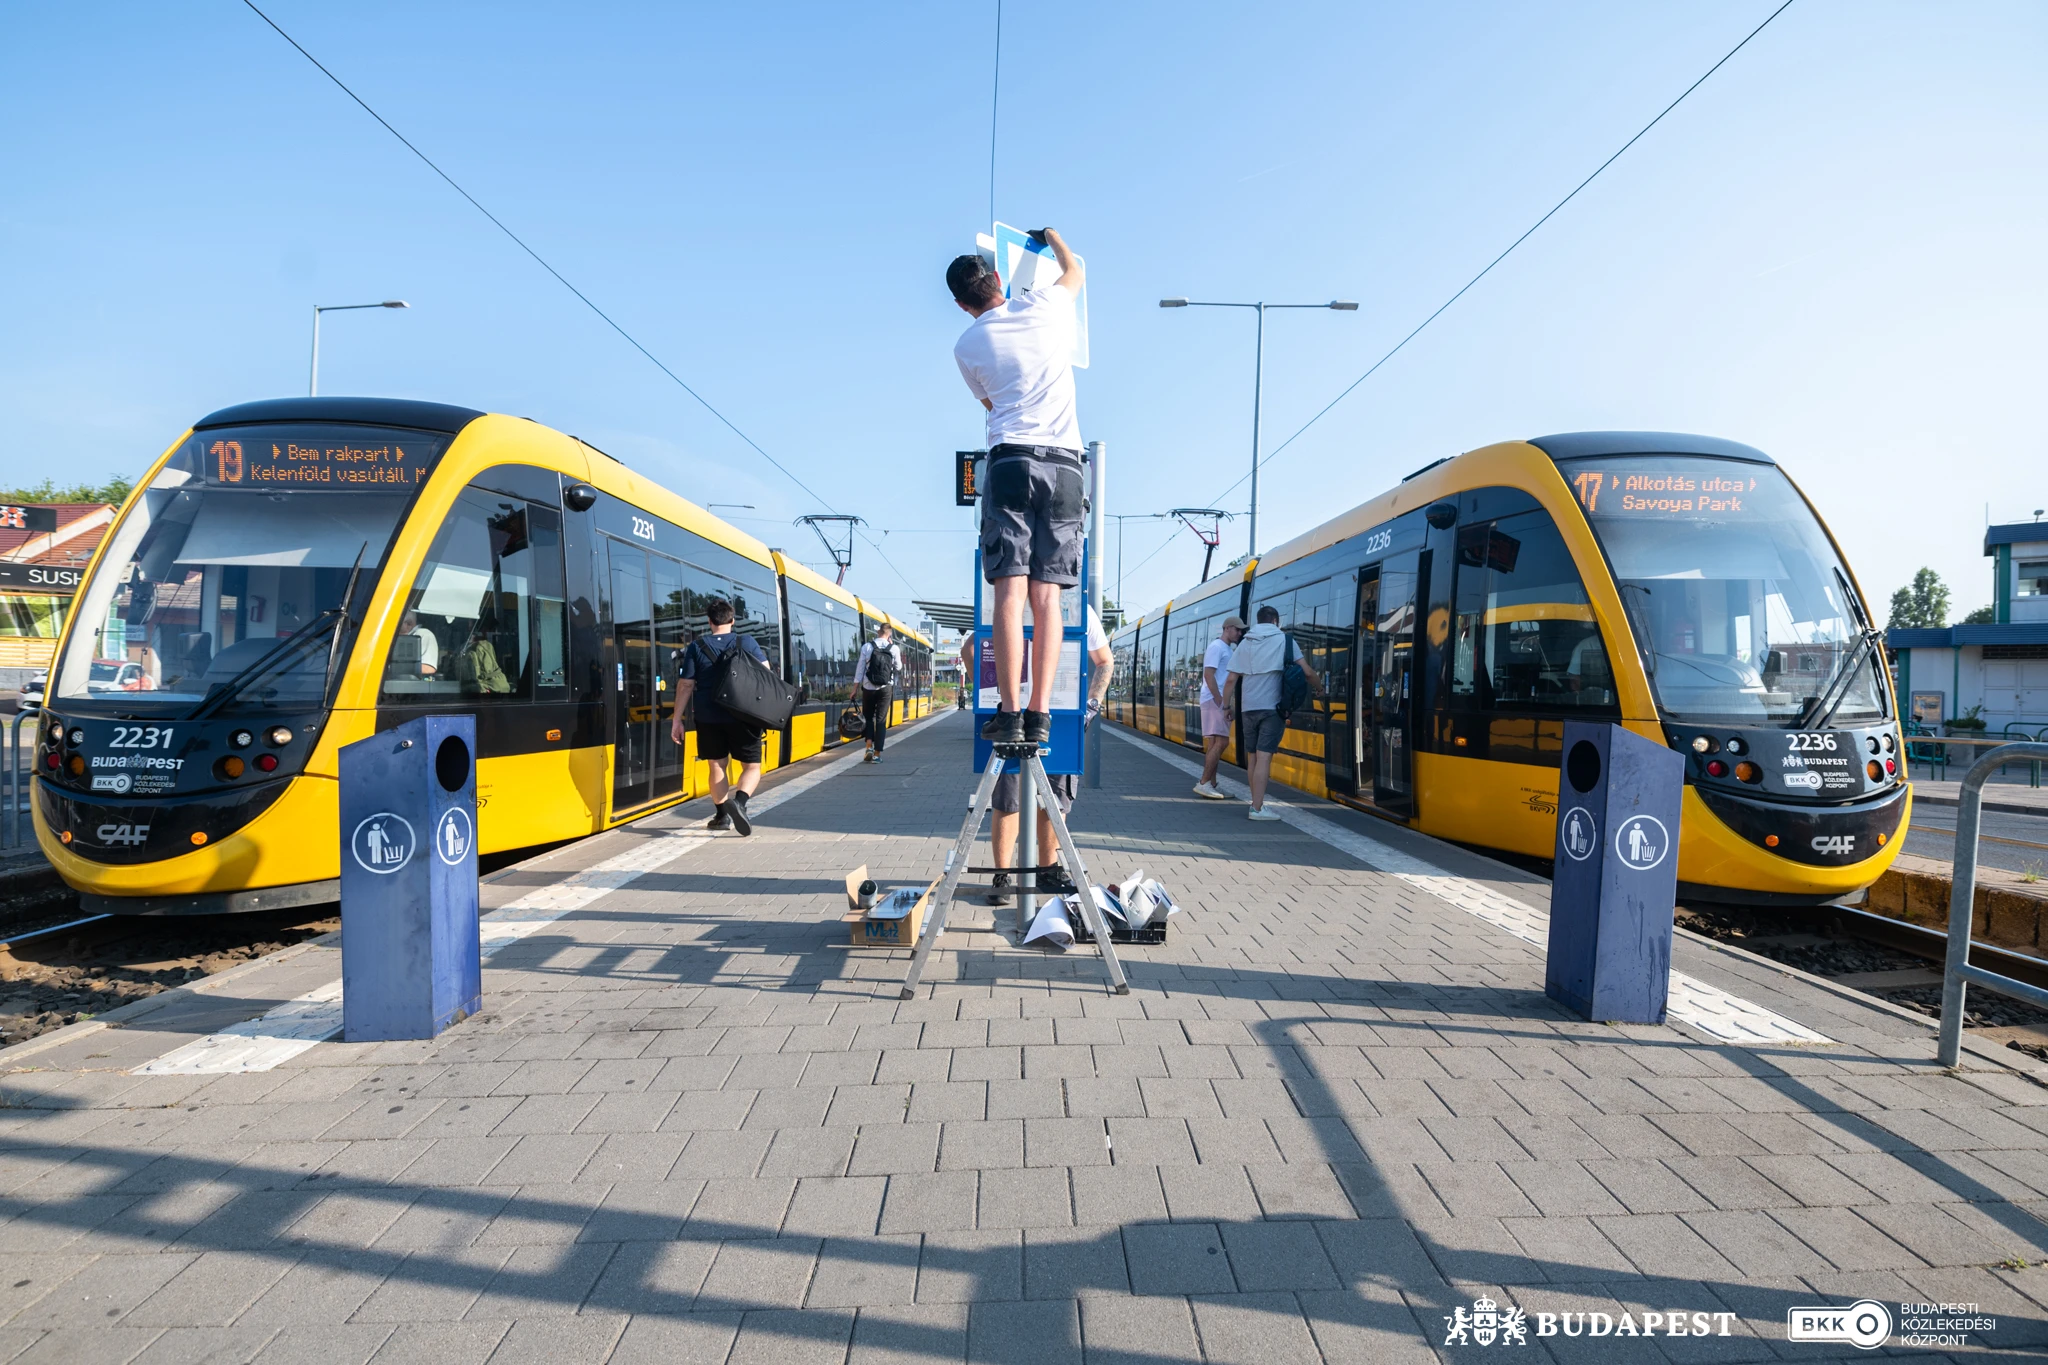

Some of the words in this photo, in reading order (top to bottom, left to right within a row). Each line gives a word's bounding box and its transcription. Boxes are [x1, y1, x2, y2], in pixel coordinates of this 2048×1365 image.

[210, 441, 243, 482] 19
[288, 444, 320, 461] Bem
[326, 445, 390, 463] rakpart
[251, 464, 330, 482] Kelenföld
[337, 465, 409, 483] vasútáll.
[1626, 475, 1696, 491] Alkotás
[1702, 478, 1744, 492] utca
[1574, 473, 1603, 512] 17
[1623, 495, 1692, 513] Savoya
[1698, 496, 1742, 511] Park
[632, 516, 655, 541] 2231
[1366, 528, 1392, 555] 2236
[109, 727, 174, 749] 2231
[1786, 734, 1837, 751] 2236
[1804, 758, 1848, 766] BUDAPEST
[97, 824, 150, 845] CAF
[1811, 835, 1855, 855] CAF
